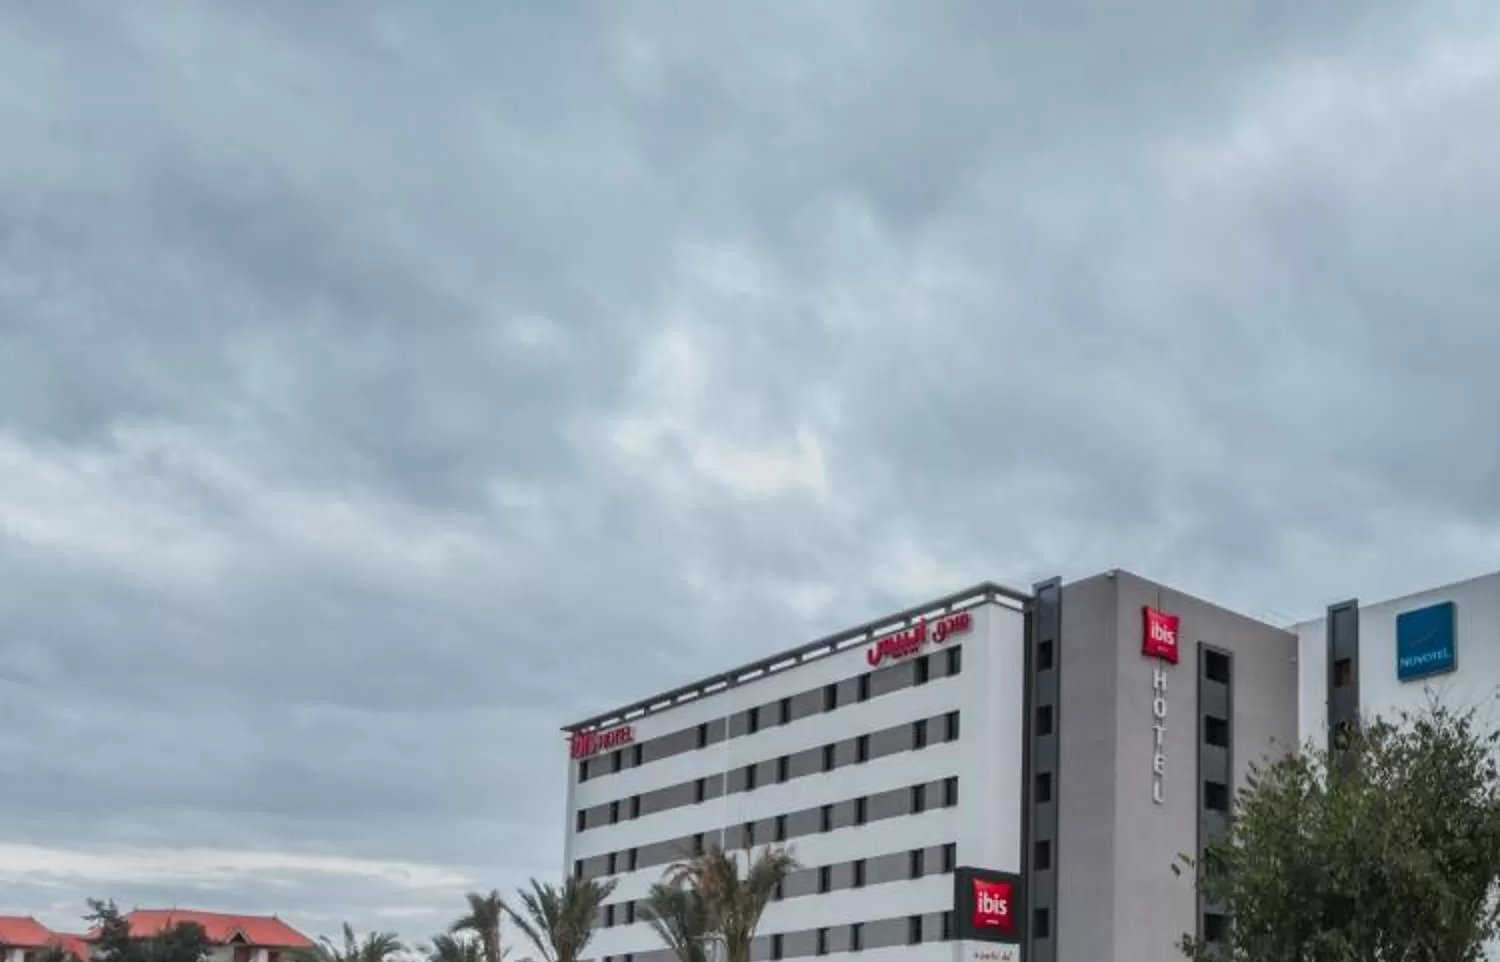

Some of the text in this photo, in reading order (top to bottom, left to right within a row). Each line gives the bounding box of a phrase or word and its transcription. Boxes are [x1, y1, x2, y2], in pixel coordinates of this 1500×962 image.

[1151, 620, 1175, 645] ibis
[1400, 648, 1453, 669] NOVOTEL
[1152, 669, 1168, 804] HOTEL
[978, 891, 1007, 915] ibis
